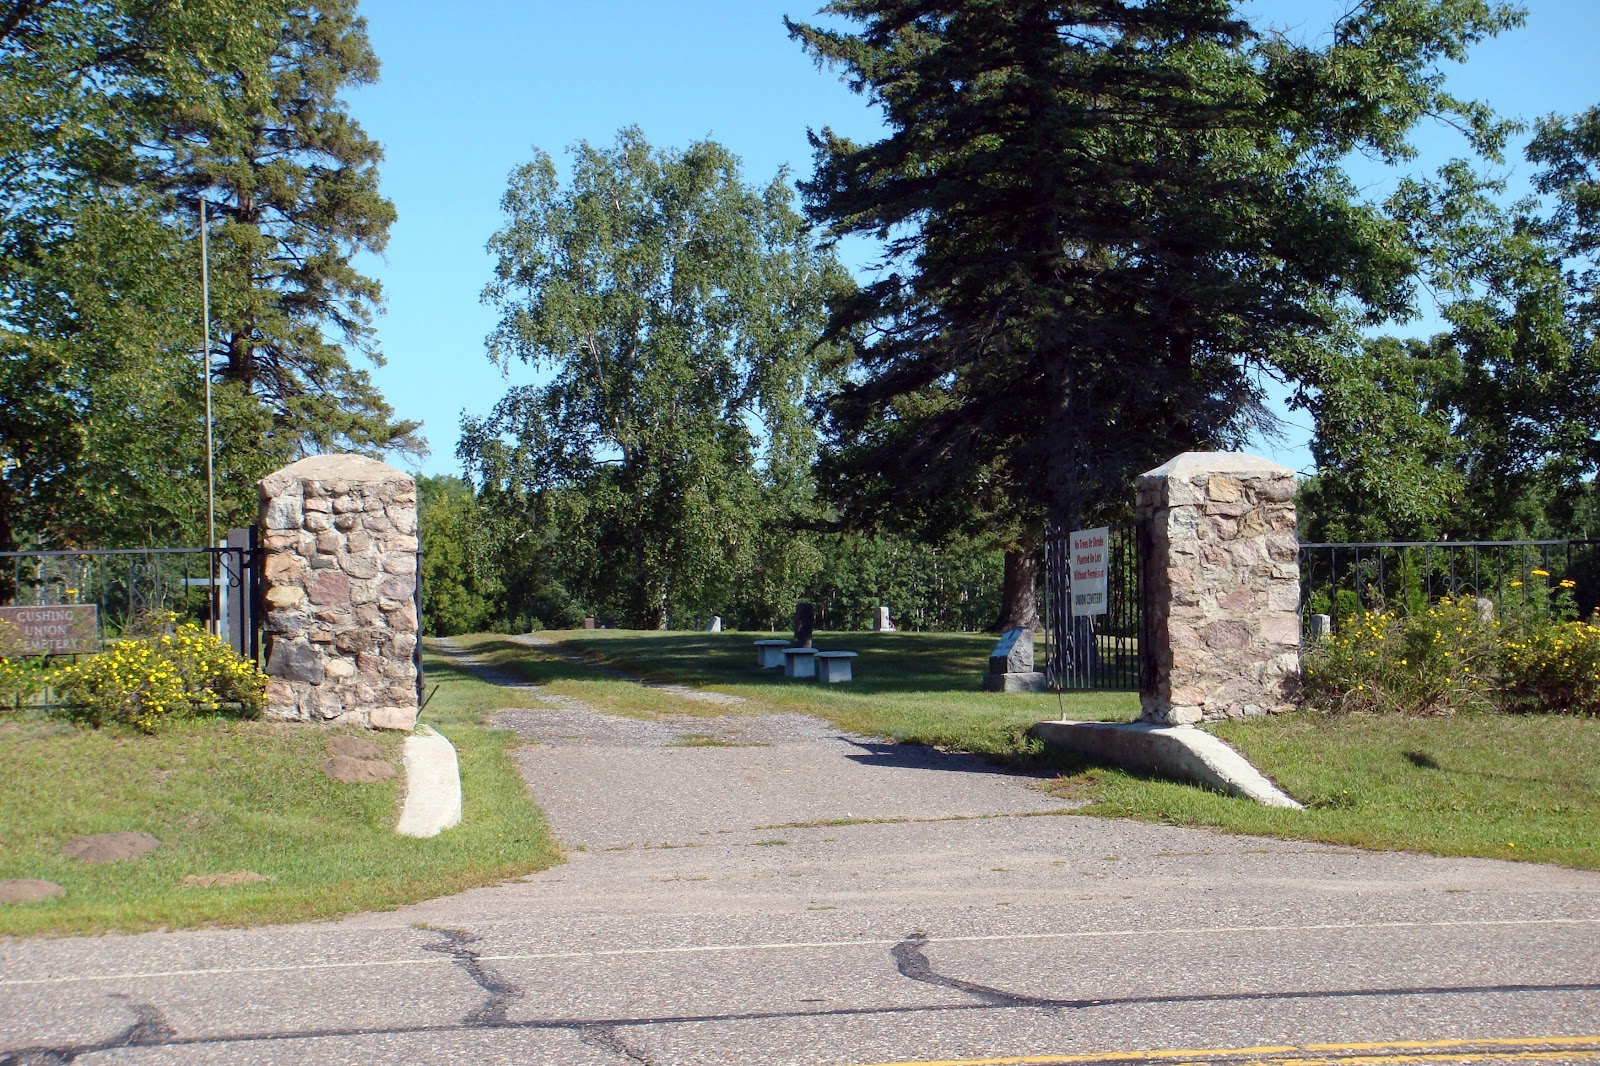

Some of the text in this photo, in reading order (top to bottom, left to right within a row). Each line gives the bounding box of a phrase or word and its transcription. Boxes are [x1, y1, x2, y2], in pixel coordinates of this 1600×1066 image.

[1080, 539, 1088, 549] Trees
[1077, 554, 1089, 564] Planted
[1090, 554, 1094, 564] On
[18, 610, 74, 622] CUSHING
[26, 626, 66, 636] UNION
[15, 639, 78, 650] EMETERY
